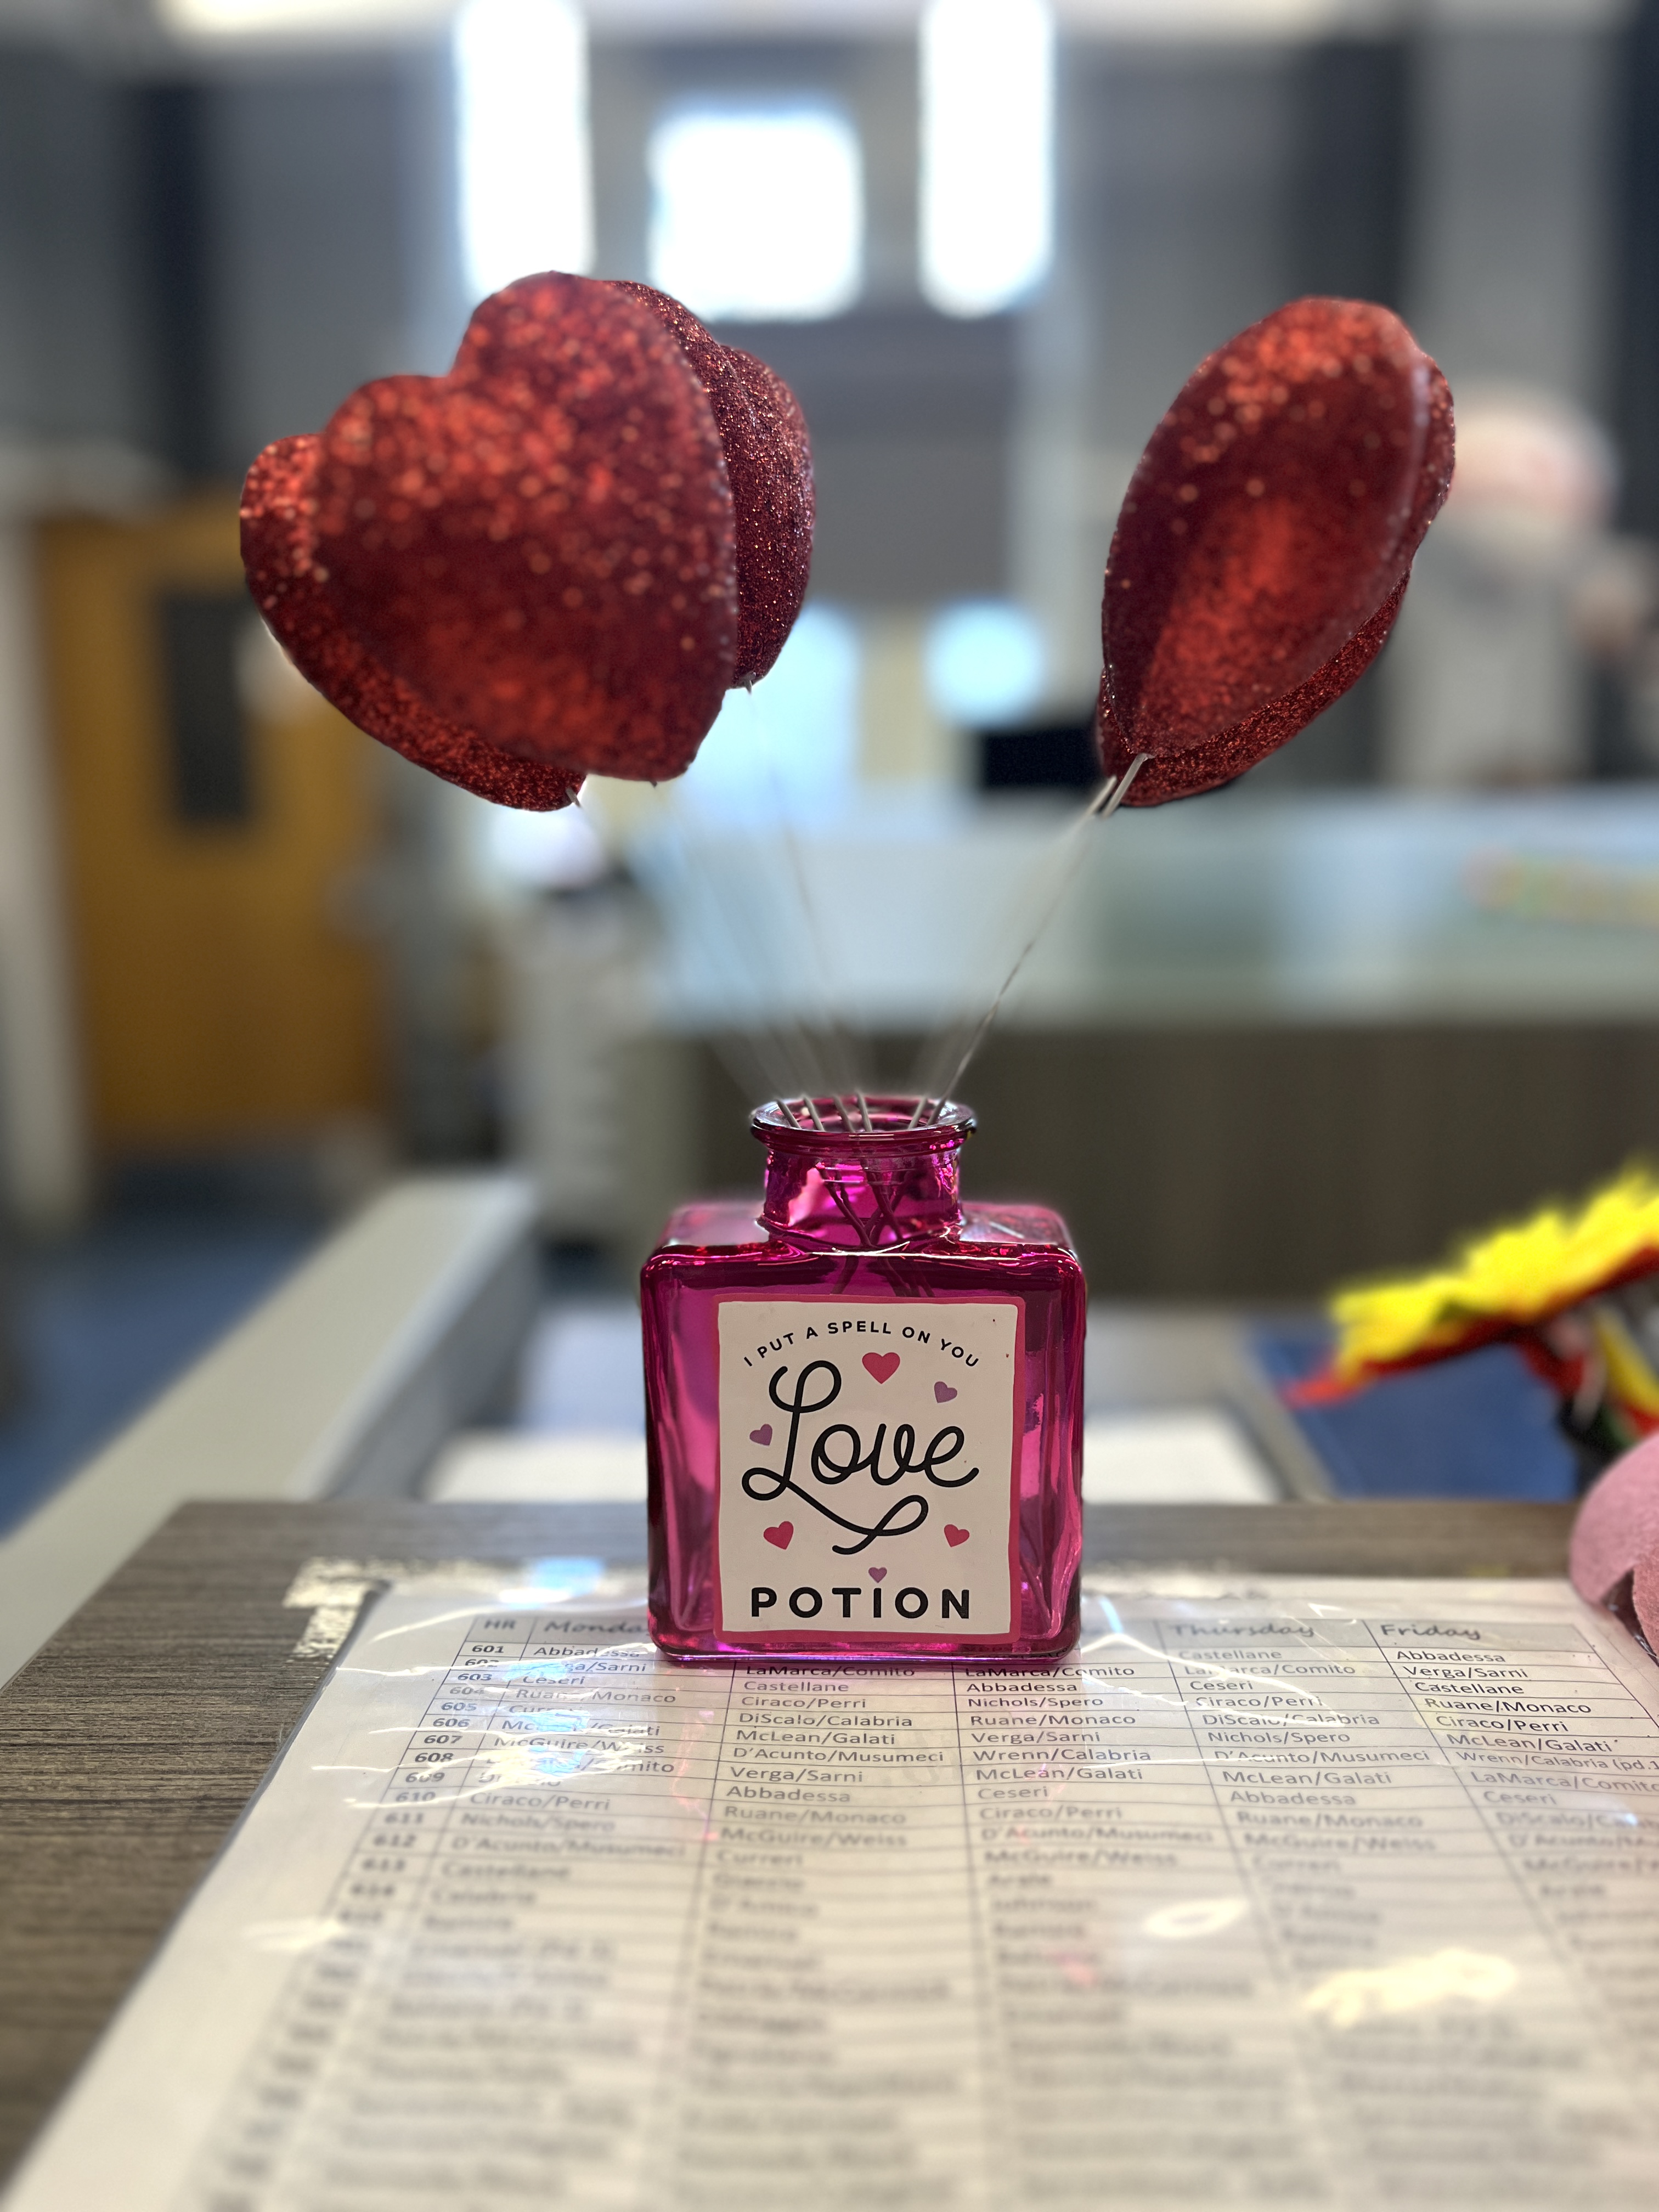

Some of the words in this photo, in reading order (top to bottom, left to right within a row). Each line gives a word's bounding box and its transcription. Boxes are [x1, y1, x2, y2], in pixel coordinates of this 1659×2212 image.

[744, 1356, 753, 1367] I
[757, 1332, 795, 1359] PUT
[806, 1327, 819, 1340] A
[827, 1321, 892, 1335] SPELL
[902, 1326, 930, 1344] ON
[940, 1339, 979, 1367] YOU
[742, 1360, 979, 1555] Love
[751, 1586, 970, 1620] POTION
[544, 1619, 648, 1633] Monda
[1380, 1624, 1481, 1641] Friday
[472, 1645, 504, 1654] 601
[1178, 1649, 1283, 1660] Castellane
[1396, 1650, 1506, 1663] Abbadessa
[457, 1673, 493, 1681] 603
[746, 1666, 916, 1678] LaMarca/Comito
[965, 1667, 1135, 1678] LaMarca/Comito
[1184, 1664, 1356, 1677] Laarca/Comito
[1403, 1666, 1529, 1679] Verga/Sarni
[449, 1686, 485, 1695] 604
[743, 1681, 849, 1692] Castellane
[967, 1682, 1077, 1692] Abbadessa
[1190, 1680, 1254, 1690] Ceseri
[1415, 1681, 1525, 1695] Castellane
[441, 1702, 477, 1711] 605
[741, 1696, 866, 1710] Ciraco/Perri
[968, 1697, 1104, 1709] Nichols/Spero
[1196, 1695, 1323, 1708] Ciraco/Perri
[1424, 1698, 1592, 1714] Ruane/Monaco
[433, 1718, 470, 1727] 606
[738, 1713, 913, 1727] DiScalo/Calabria
[970, 1714, 1136, 1726] Ruane/Monaco
[1436, 1716, 1569, 1733] Ciraco/Perri
[424, 1735, 463, 1744] 607
[736, 1729, 895, 1745] McLean/Galati
[972, 1731, 1101, 1744] Verga/Sarni
[1207, 1731, 1350, 1745] Nichols/Spero
[1446, 1734, 1612, 1752] McLean/Galati
[415, 1752, 454, 1763] 608
[733, 1747, 944, 1762] D'Acunto/Musumeci
[973, 1748, 1151, 1762] Wrenn/Calabria
[1456, 1751, 1609, 1768] Wrenn/Calabria
[405, 1772, 445, 1783] 609
[730, 1767, 864, 1783] Verga/Sarni
[976, 1767, 1143, 1781] McLean/Galati
[1222, 1770, 1392, 1786] McLean/Galati
[396, 1791, 436, 1803] 610
[726, 1786, 851, 1803] Abbadessa
[978, 1786, 1049, 1799] Ceseri
[1230, 1791, 1356, 1805] Abbadessa
[1483, 1791, 1557, 1805] Ceseri
[470, 1791, 611, 1810] Ciraco/Perri
[724, 1807, 907, 1825] Ruane/Monaco
[980, 1805, 1122, 1820] Ciraco/Perri
